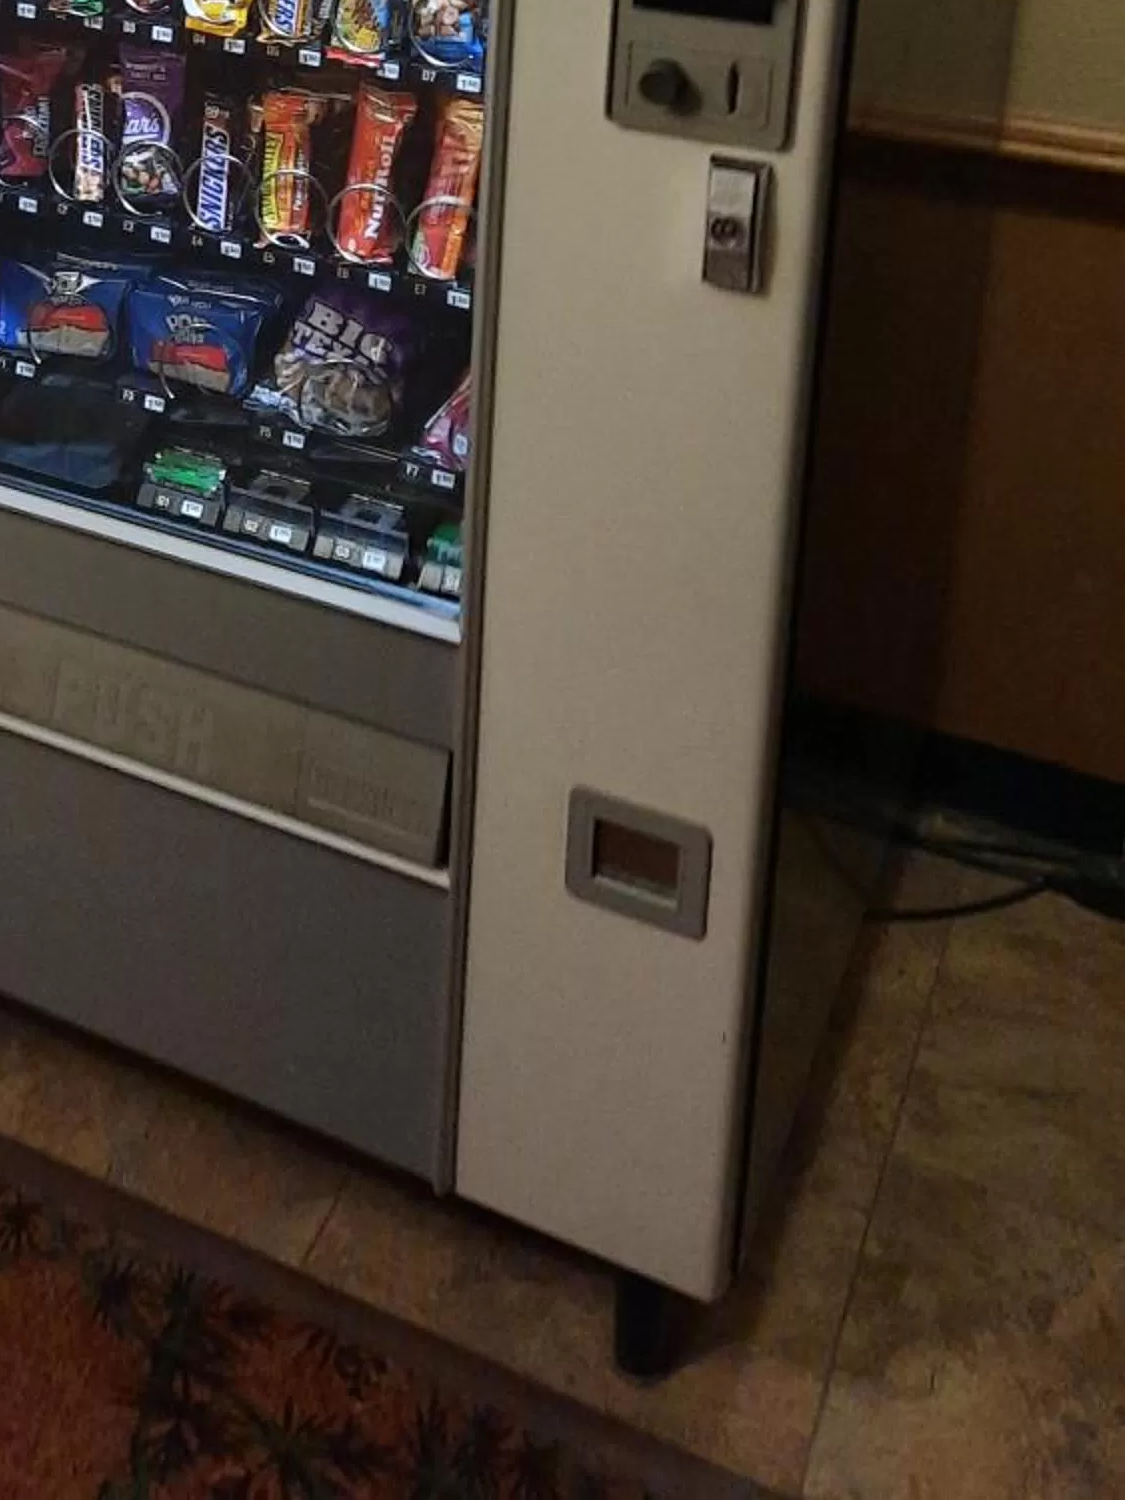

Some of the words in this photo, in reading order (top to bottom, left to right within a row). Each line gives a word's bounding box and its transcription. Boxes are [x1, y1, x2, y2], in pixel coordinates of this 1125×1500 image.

[422, 69, 436, 82] D7
[124, 112, 159, 135] ar's
[198, 124, 229, 232] SNICKERS
[307, 300, 392, 366] BIG
